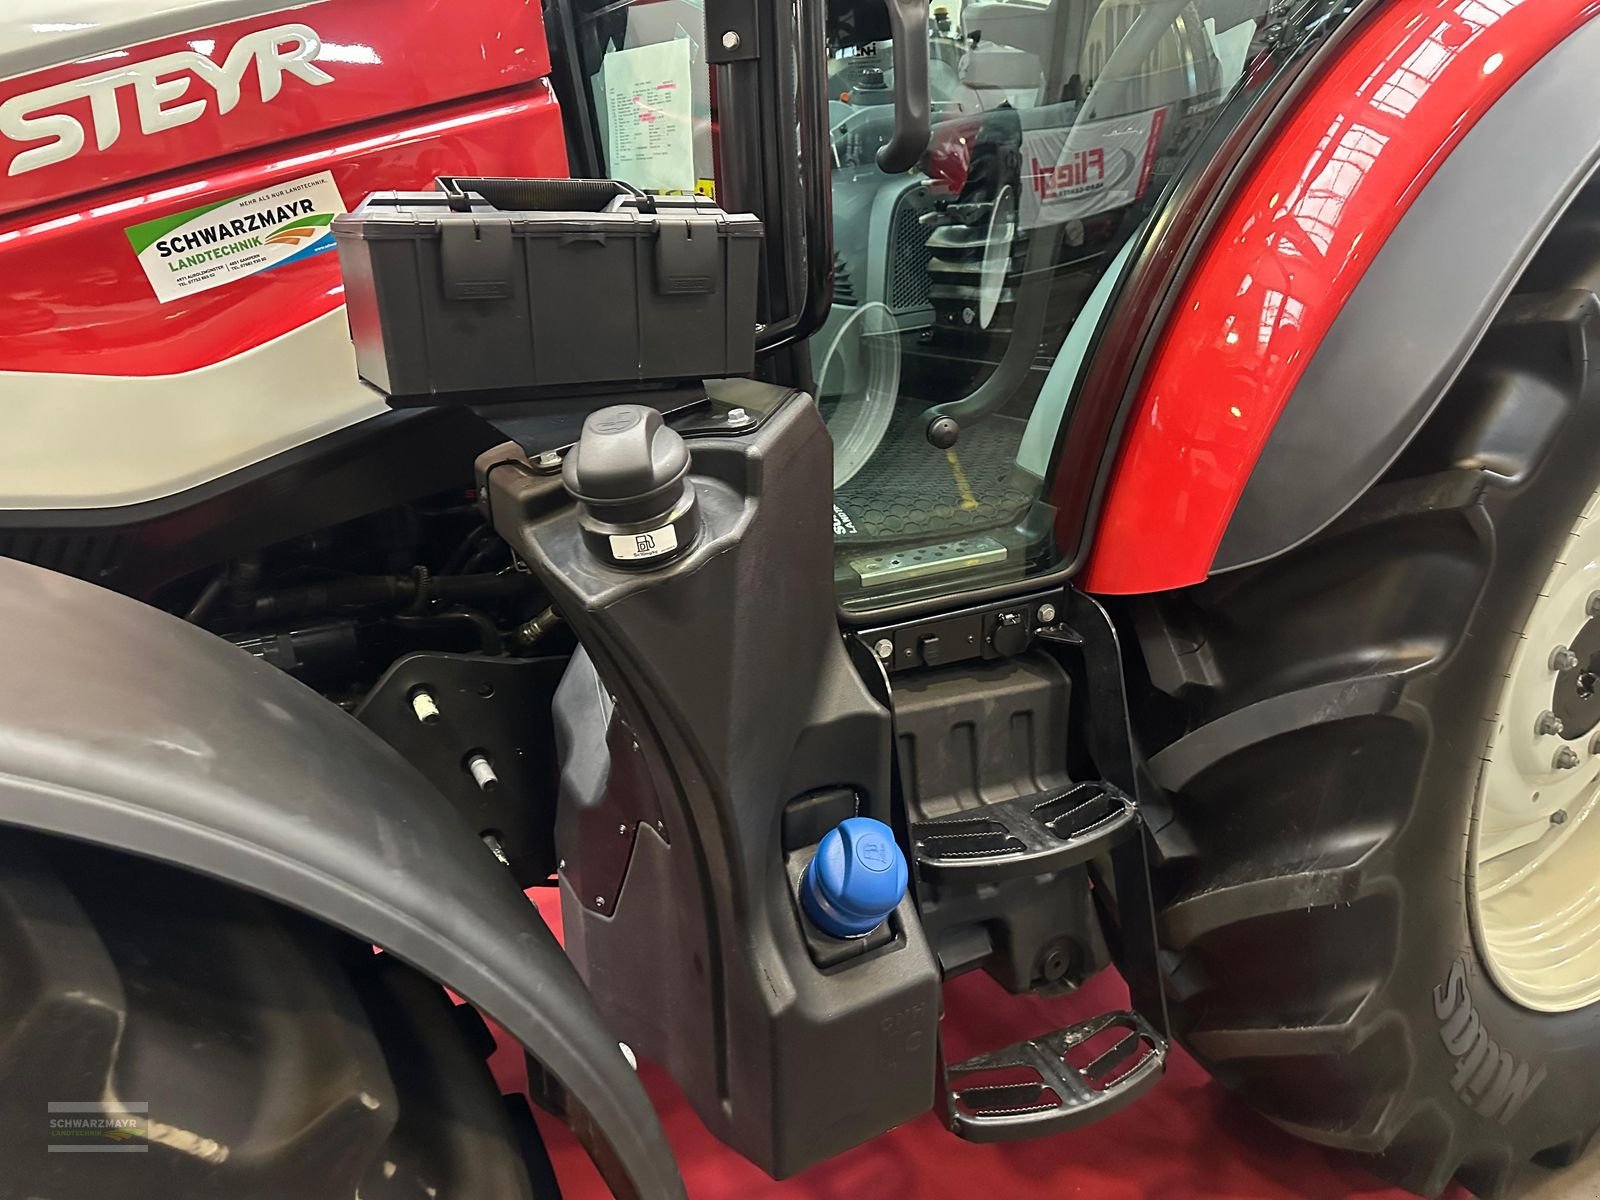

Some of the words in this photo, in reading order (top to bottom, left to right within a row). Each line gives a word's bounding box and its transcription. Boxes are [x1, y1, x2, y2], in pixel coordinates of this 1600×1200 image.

[0, 23, 335, 177] STEYR
[156, 198, 316, 258] SCHWARZMAYR
[239, 198, 257, 207] MEHR
[258, 194, 271, 202] ALS
[271, 190, 285, 198] NUR
[167, 235, 263, 273] LANDTECHNIK
[1433, 957, 1547, 1126] Mitas
